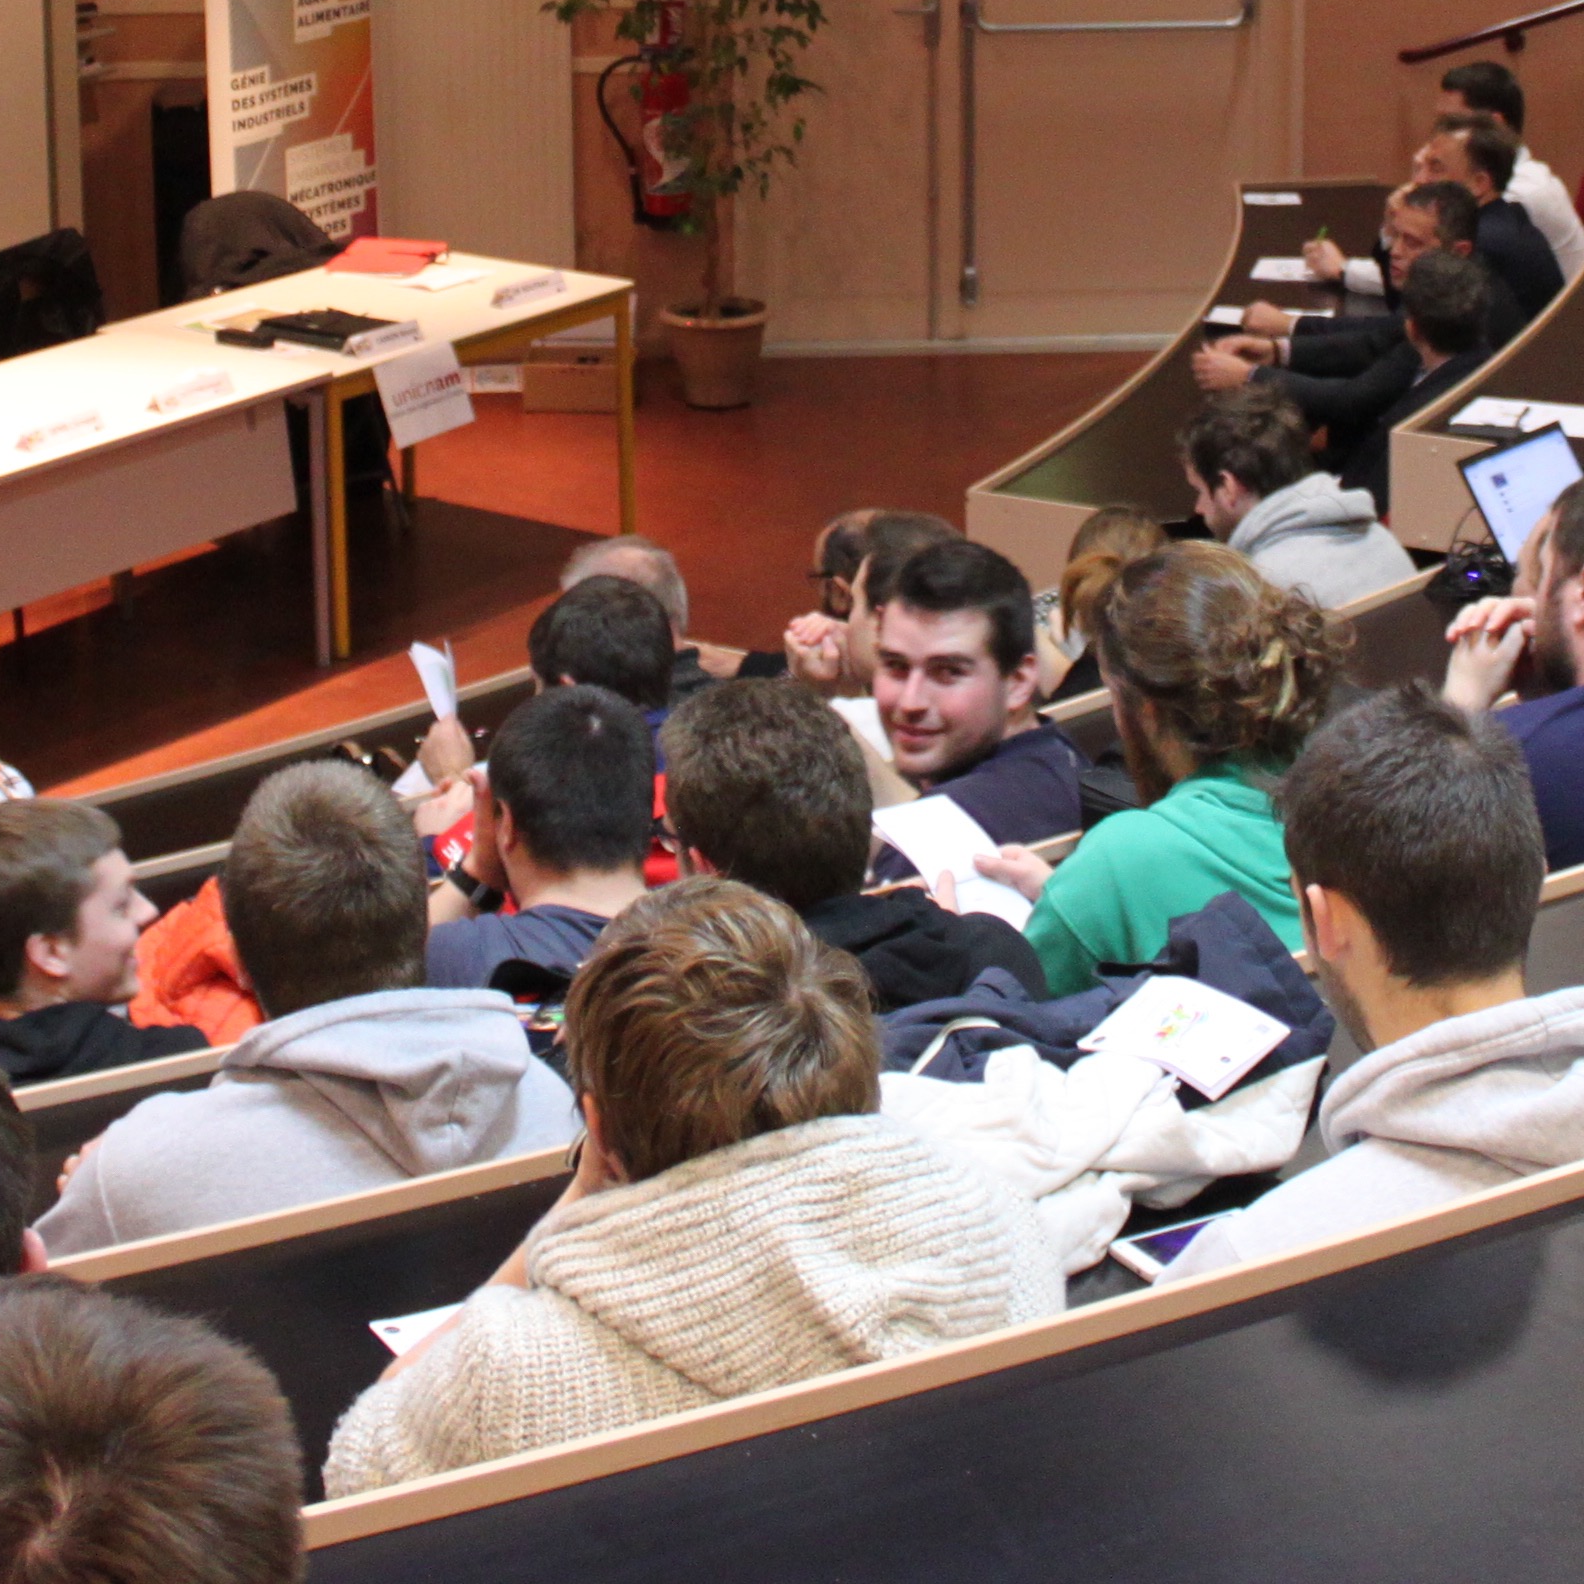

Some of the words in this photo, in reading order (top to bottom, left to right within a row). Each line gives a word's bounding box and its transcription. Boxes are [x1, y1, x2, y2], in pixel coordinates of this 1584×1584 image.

[231, 70, 265, 91] GÉNIE
[231, 97, 255, 112] DES
[232, 101, 306, 132] INDUSTRIELS
